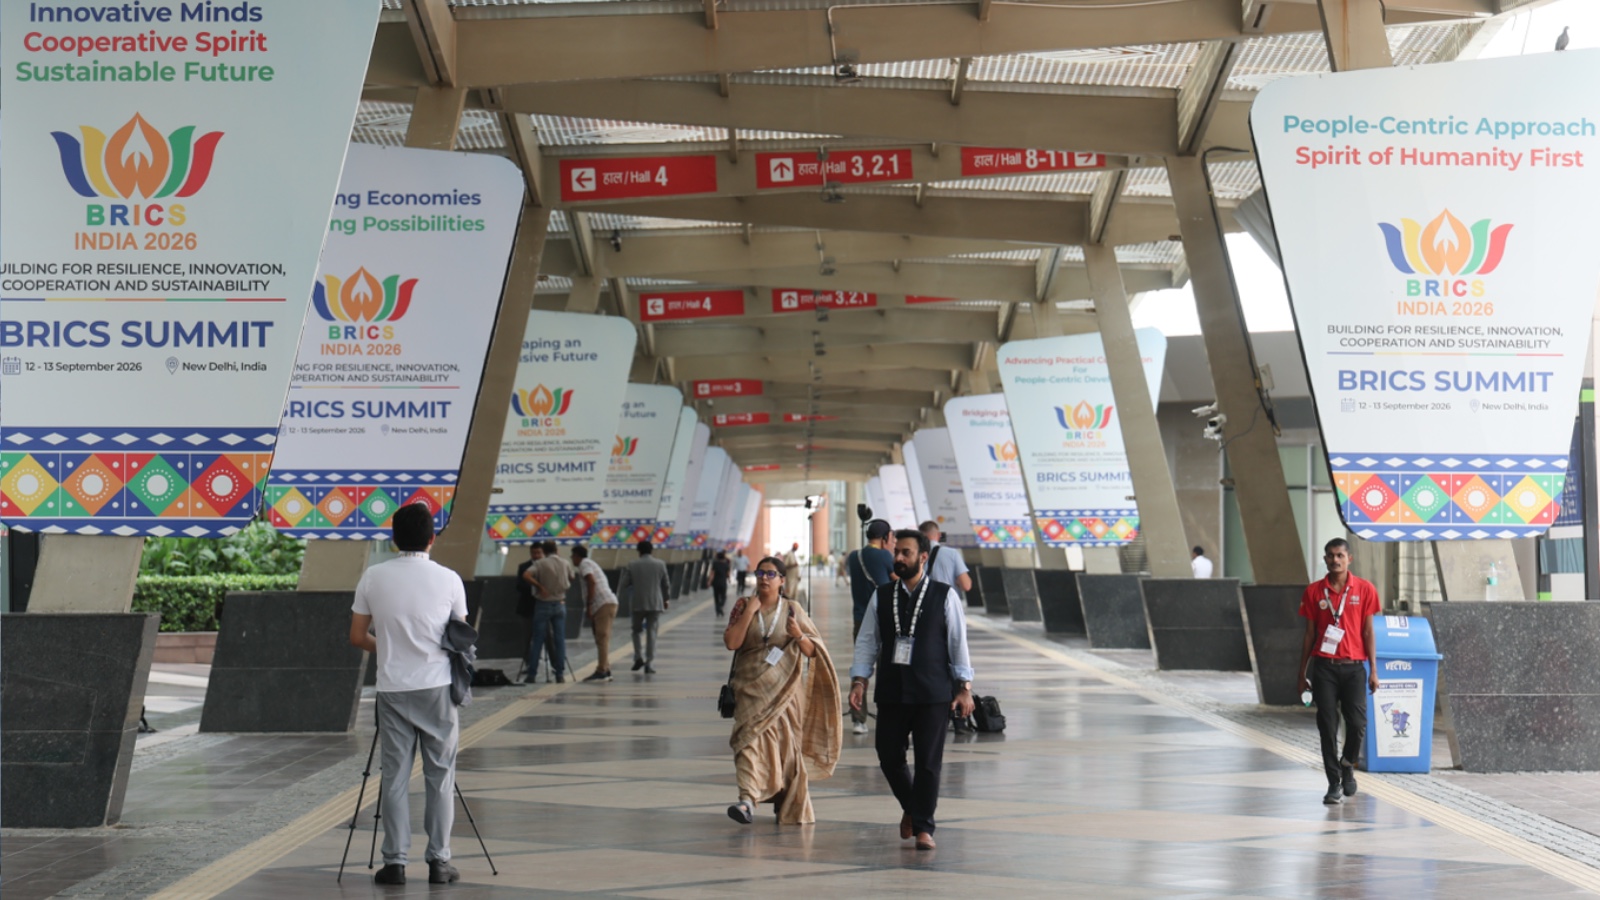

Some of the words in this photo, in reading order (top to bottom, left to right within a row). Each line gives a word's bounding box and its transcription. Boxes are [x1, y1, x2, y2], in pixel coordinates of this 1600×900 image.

[30, 1, 172, 23] Innovative
[181, 1, 263, 23] Minds
[24, 30, 188, 57] Cooperative
[195, 30, 267, 57] Spirit
[16, 61, 176, 82] Sustainable
[184, 61, 274, 82] Future
[1283, 114, 1469, 138] People-Centric
[1475, 115, 1597, 139] Approach
[974, 155, 994, 168] हाल
[1001, 152, 1022, 165] Hall
[1025, 149, 1069, 169] 8-11
[1295, 145, 1362, 170] Spirit
[1368, 146, 1394, 166] of
[1400, 147, 1523, 171] Humanity
[1530, 148, 1584, 168] First
[797, 163, 818, 176] हाल
[826, 161, 846, 173] Hall
[602, 171, 624, 186] हाल
[630, 171, 651, 183] Hall
[654, 166, 668, 186] 4
[367, 189, 482, 206] Economies
[86, 204, 186, 226] BRICS
[363, 215, 485, 232] Possibilities
[74, 232, 138, 251] INDIA
[144, 232, 198, 251] 2026
[62, 263, 93, 275] FOR
[97, 263, 186, 277] RESILIENCE,
[189, 263, 287, 278] INNOVATION,
[2, 280, 111, 292] COOPERATION
[114, 280, 148, 292] AND
[151, 280, 270, 292] SUSTAINABILITY
[1406, 279, 1486, 298] BRICS
[702, 297, 712, 311] 4
[1397, 301, 1448, 316] INDIA
[1452, 301, 1494, 316] 2026
[0, 320, 111, 349] BRICS
[121, 320, 274, 349] SUMMIT
[328, 325, 394, 340] BRICS
[1327, 324, 1385, 335] BUILDING
[1388, 324, 1412, 335] FOR
[1414, 325, 1485, 337] RESILIENCE,
[1487, 326, 1564, 338] INNOVATION,
[321, 343, 363, 356] INDIA
[366, 343, 402, 356] 2026
[564, 339, 582, 348] an
[1340, 337, 1427, 348] COOPERATION
[1429, 338, 1455, 348] AND
[1458, 338, 1551, 349] SUSTAINABILITY
[553, 351, 598, 362] Future
[1004, 356, 1053, 366] Advancing
[25, 361, 36, 371] 12
[43, 361, 54, 371] 13
[55, 361, 115, 375] September
[116, 361, 143, 371] 2026
[182, 361, 207, 372] New
[208, 360, 239, 373] Delhi,
[241, 361, 267, 371] India
[312, 363, 333, 372] FOR
[396, 363, 460, 373] INNOVATION,
[347, 374, 369, 383] AND
[371, 374, 449, 383] SUSTAINABILITY
[1338, 369, 1427, 392] BRICS
[1434, 370, 1554, 393] SUMMIT
[351, 401, 452, 419] SUMMIT
[1358, 402, 1367, 410] 12
[1373, 402, 1381, 410] 13
[1383, 402, 1429, 412] September
[1430, 402, 1451, 410] 2026
[1482, 402, 1500, 411] New
[1528, 402, 1549, 411] India
[521, 418, 561, 428] BRICS
[309, 427, 346, 435] September
[517, 428, 542, 437] INDIA
[545, 428, 566, 437] 2026
[1066, 431, 1102, 440] BRICS
[537, 461, 596, 474] SUMMIT
[1037, 472, 1076, 482] BRICS
[611, 489, 653, 498] SUMMIT
[1385, 661, 1413, 671] VECTUS
